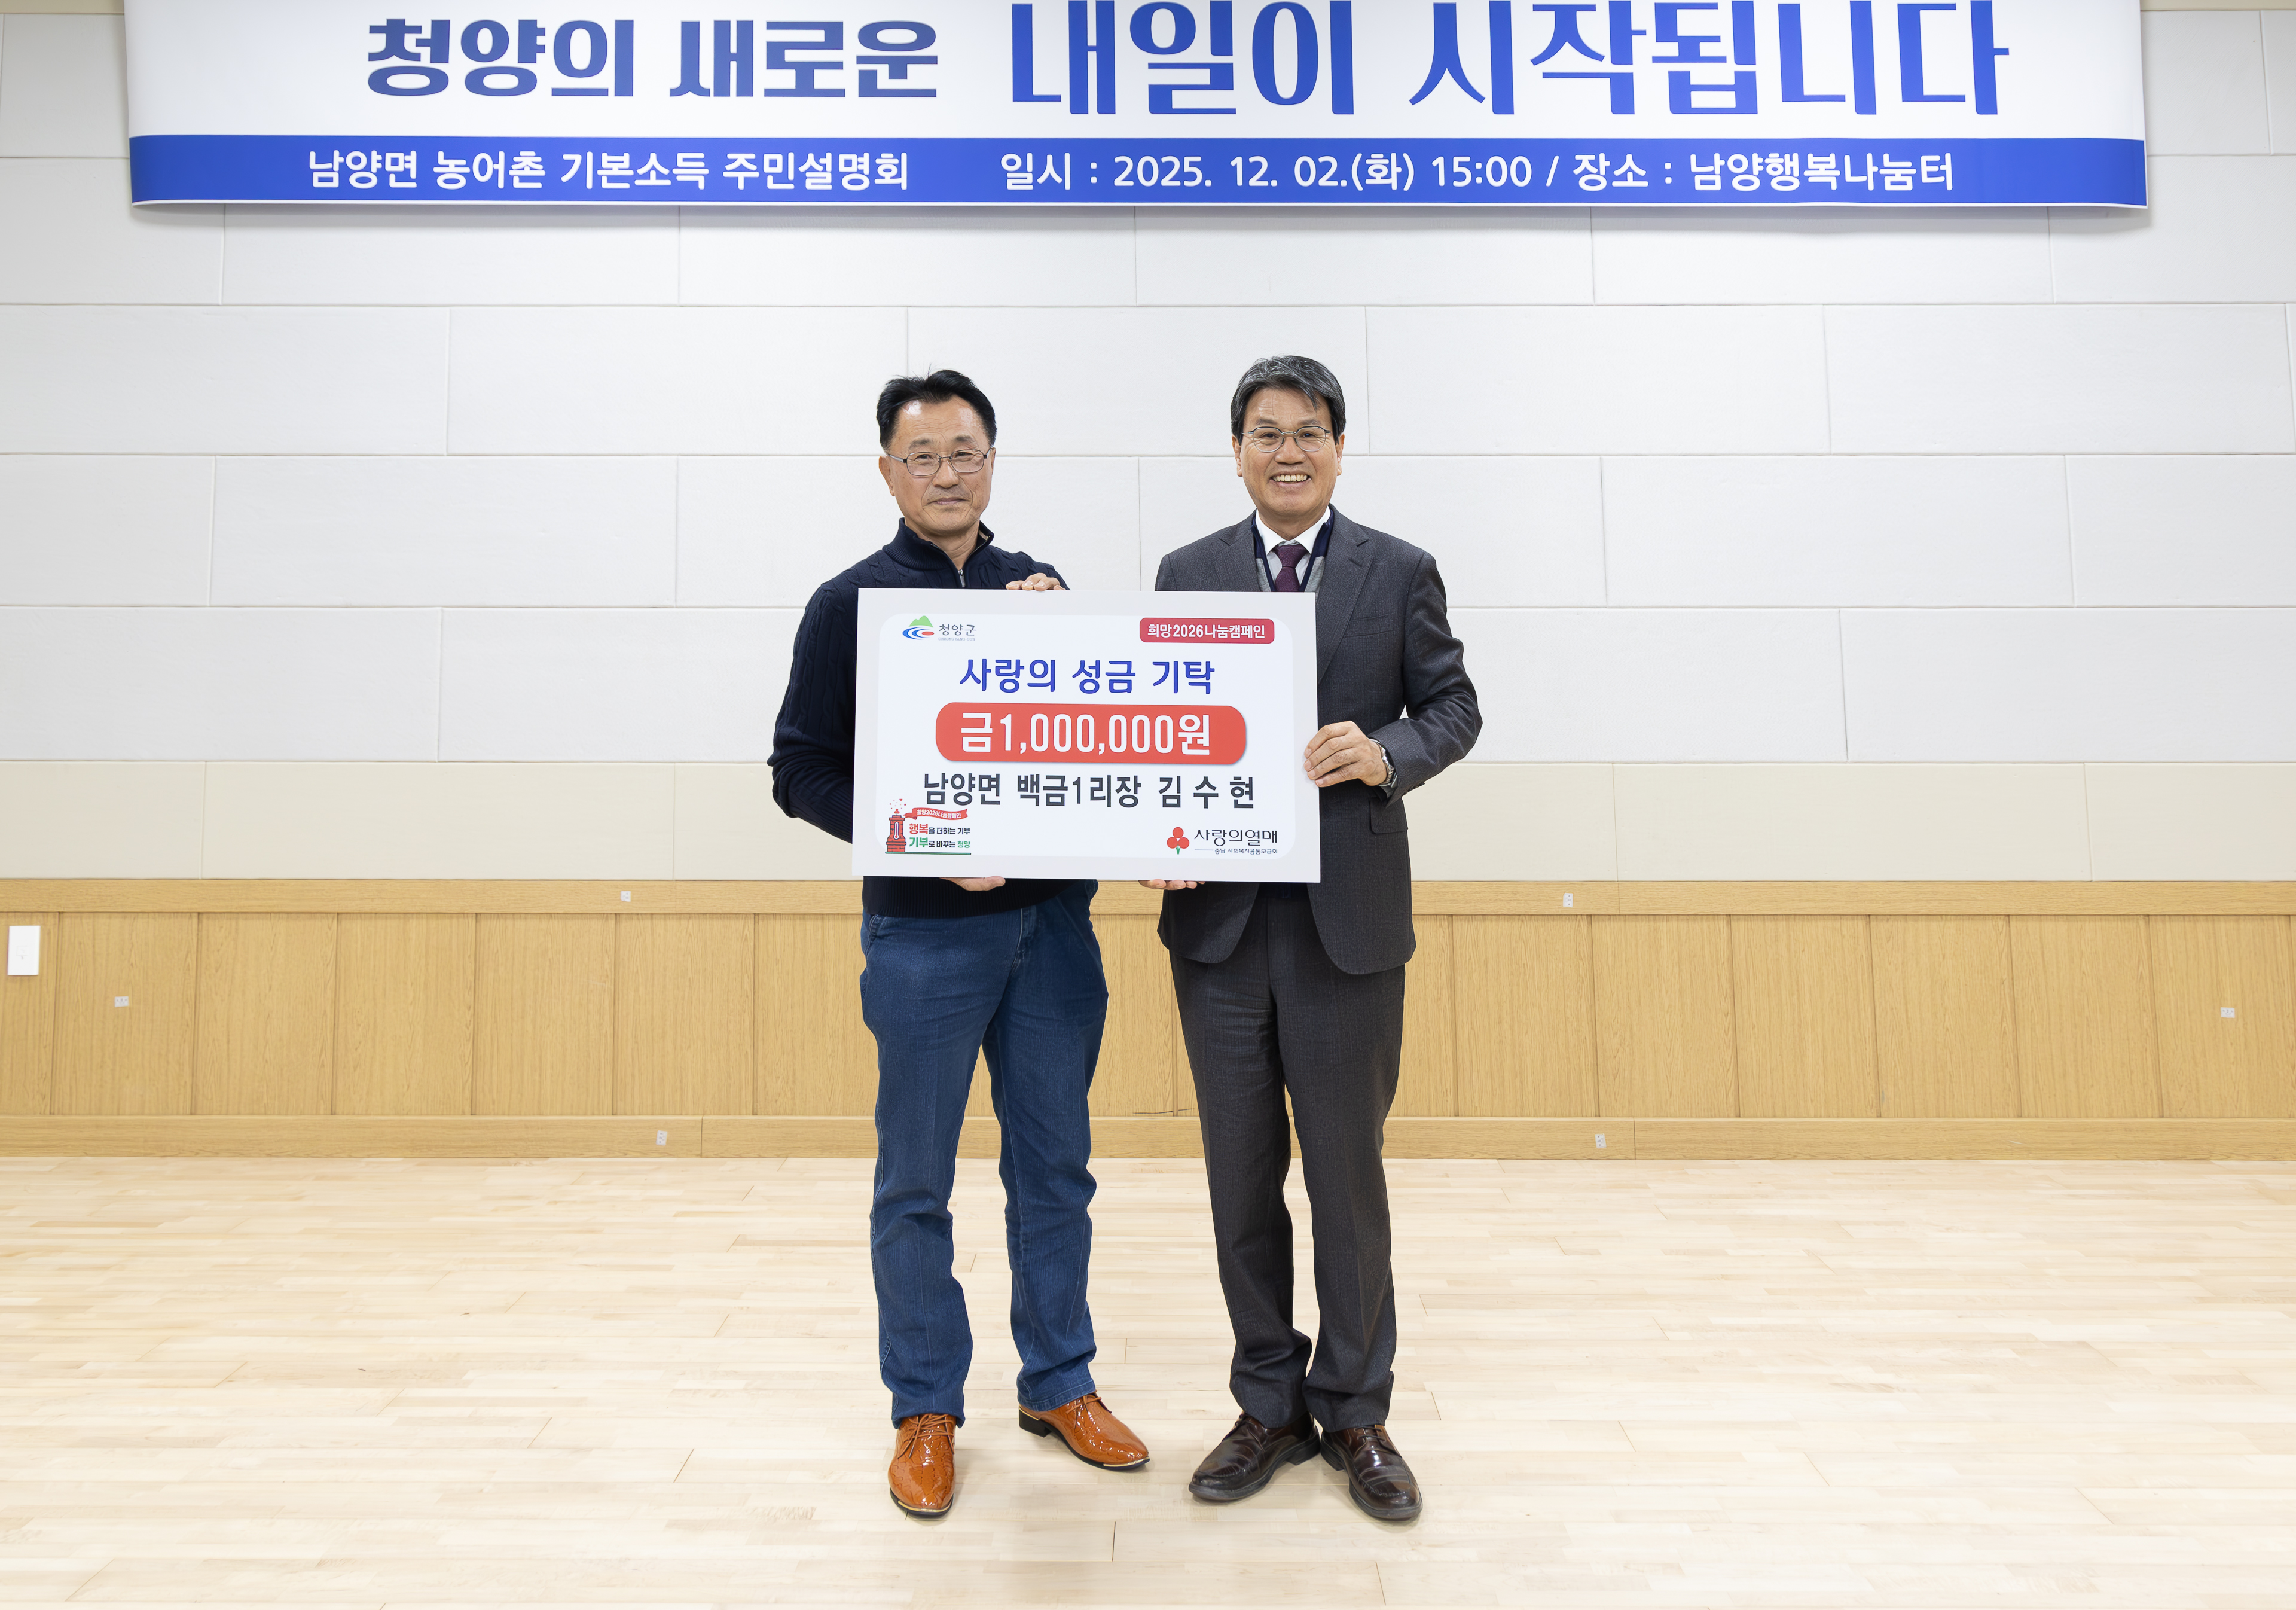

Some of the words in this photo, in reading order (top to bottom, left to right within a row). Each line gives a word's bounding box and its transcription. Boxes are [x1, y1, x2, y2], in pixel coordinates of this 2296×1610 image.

[368, 19, 634, 96] 청양의
[670, 20, 938, 97] 새로운
[1012, 0, 1354, 114] 내일이
[1409, 0, 2009, 115] 시작됩니다
[310, 150, 417, 188] 남양면
[433, 151, 545, 189] 농어촌
[561, 151, 709, 190] 기본소득
[723, 152, 907, 190] 주민설명회
[1001, 153, 1070, 190] 일시
[1114, 156, 1211, 187] 2025.
[1231, 156, 1277, 187] 12.
[1294, 153, 1414, 191] 02.(화)
[1432, 156, 1532, 187] 15:00
[1573, 153, 1648, 191] 장소
[1690, 153, 1952, 191] 남양행복나눔터
[939, 624, 976, 636] 청양군
[1148, 624, 1265, 638] 희망2026나눔캠페인
[960, 659, 1055, 693] 사랑의
[1072, 660, 1135, 694] 성금
[1153, 661, 1214, 694] 기탁
[961, 713, 1210, 755] 금1,000,000원
[924, 773, 1000, 806] 남양면
[1018, 774, 1141, 807] 백금1리장
[909, 823, 935, 834] 행복을
[936, 827, 956, 835] 더하는
[1195, 830, 1277, 846] 사랑의열매
[909, 837, 935, 848] 기부로
[957, 840, 970, 849] 청양
